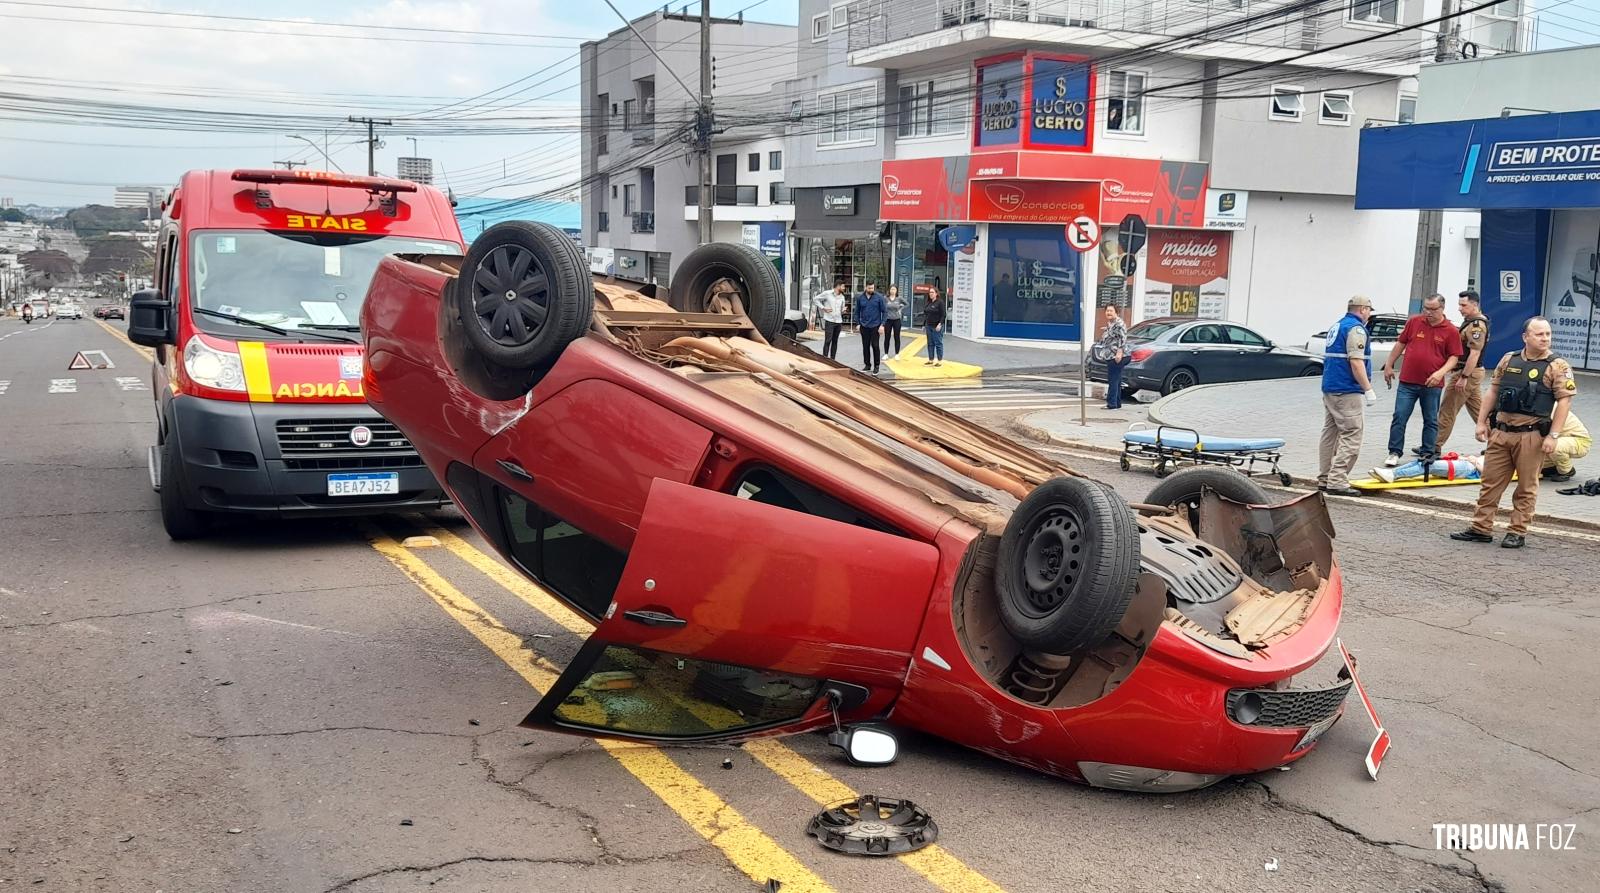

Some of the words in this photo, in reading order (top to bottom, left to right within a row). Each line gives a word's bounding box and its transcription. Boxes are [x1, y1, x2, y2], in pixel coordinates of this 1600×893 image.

[1035, 98, 1085, 116] LUCRO
[1035, 115, 1084, 131] CERTO
[1498, 147, 1538, 165] BEM
[1492, 173, 1530, 183] PROTEÇÃO
[1531, 173, 1568, 182] VEICULAR
[1568, 173, 1585, 181] QUE
[1000, 193, 1019, 204] HS
[1021, 201, 1085, 210] consórcios
[1077, 222, 1089, 243] E
[1160, 239, 1218, 257] metade
[1161, 256, 1171, 266] da
[1171, 256, 1200, 268] parcela
[1017, 277, 1055, 287] LUCRO
[1506, 276, 1514, 288] E
[1016, 289, 1054, 299] CERTO
[335, 480, 391, 494] BEA7J52
